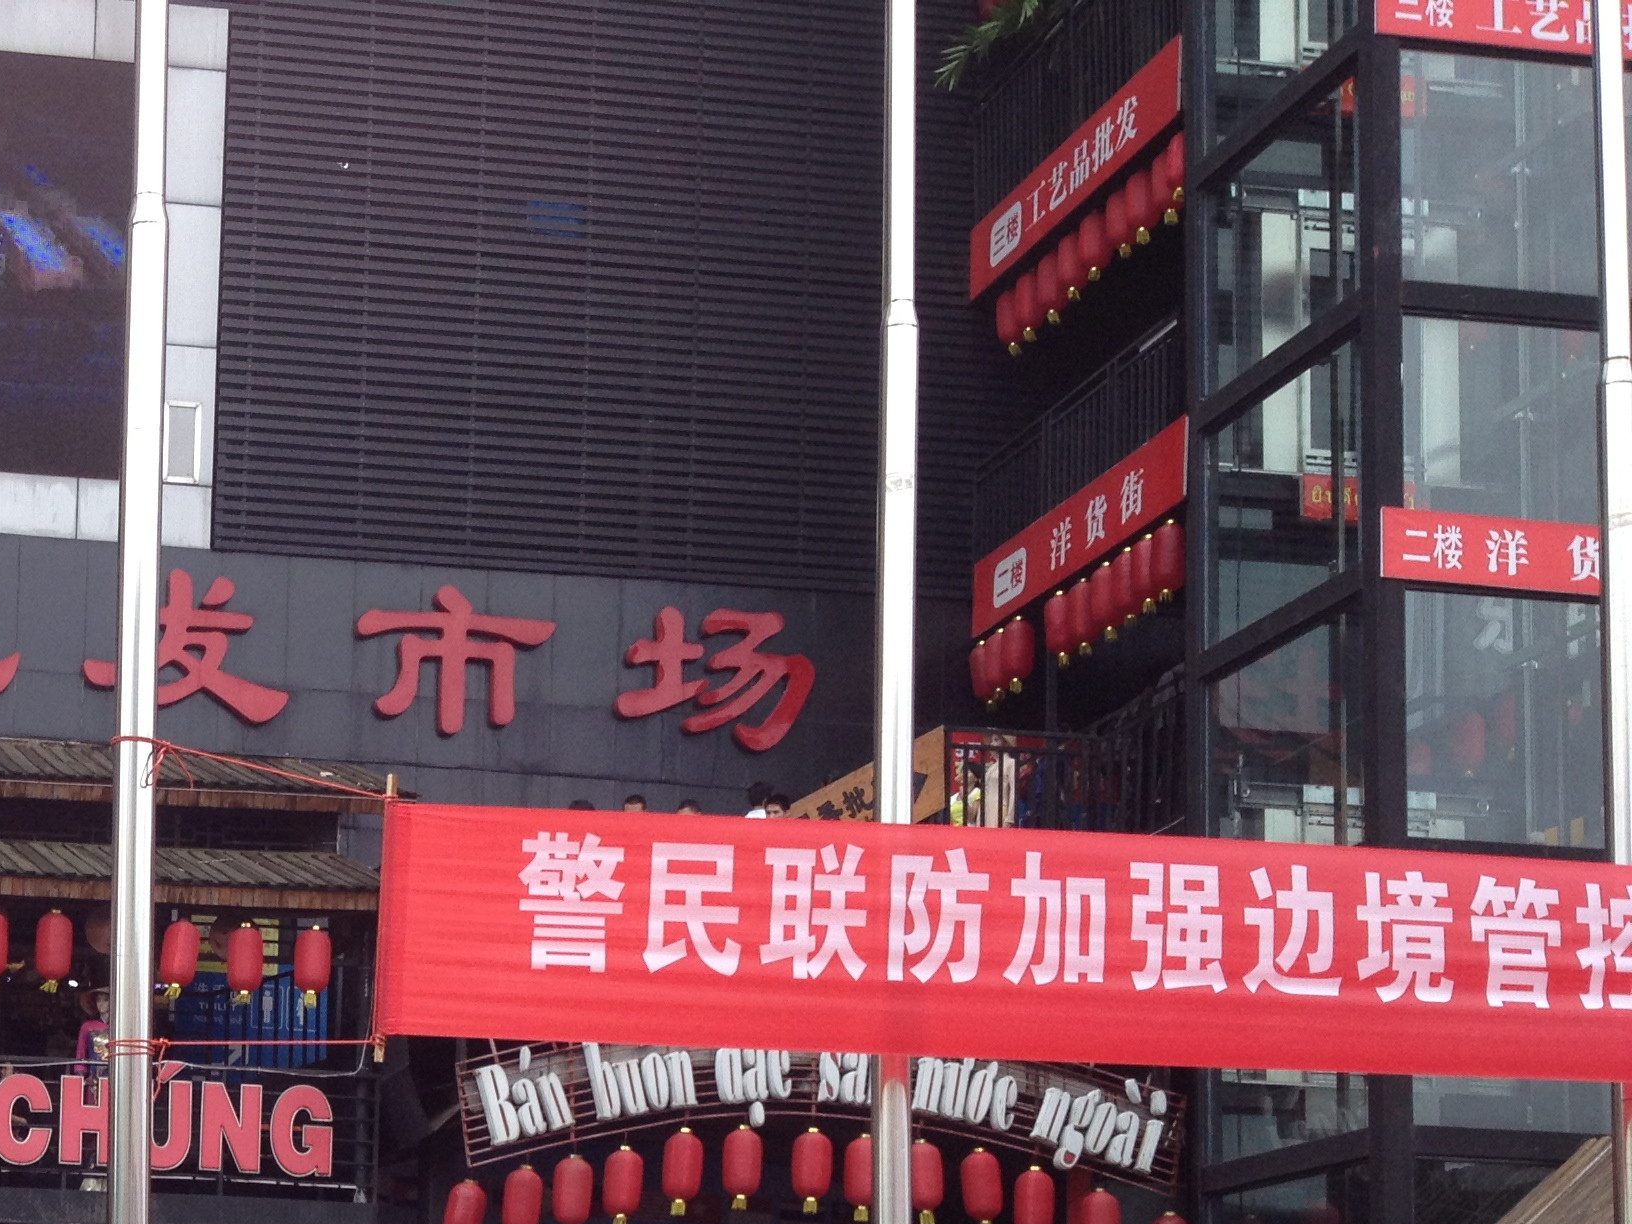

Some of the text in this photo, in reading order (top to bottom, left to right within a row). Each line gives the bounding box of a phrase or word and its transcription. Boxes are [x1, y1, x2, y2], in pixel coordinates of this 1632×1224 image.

[992, 95, 1139, 258] 三楼 工艺品批发
[995, 467, 1145, 598] 二楼 洋货街
[1402, 523, 1464, 570] 二楼
[474, 1044, 576, 1146] Bán
[1029, 1078, 1168, 1174] ngoài
